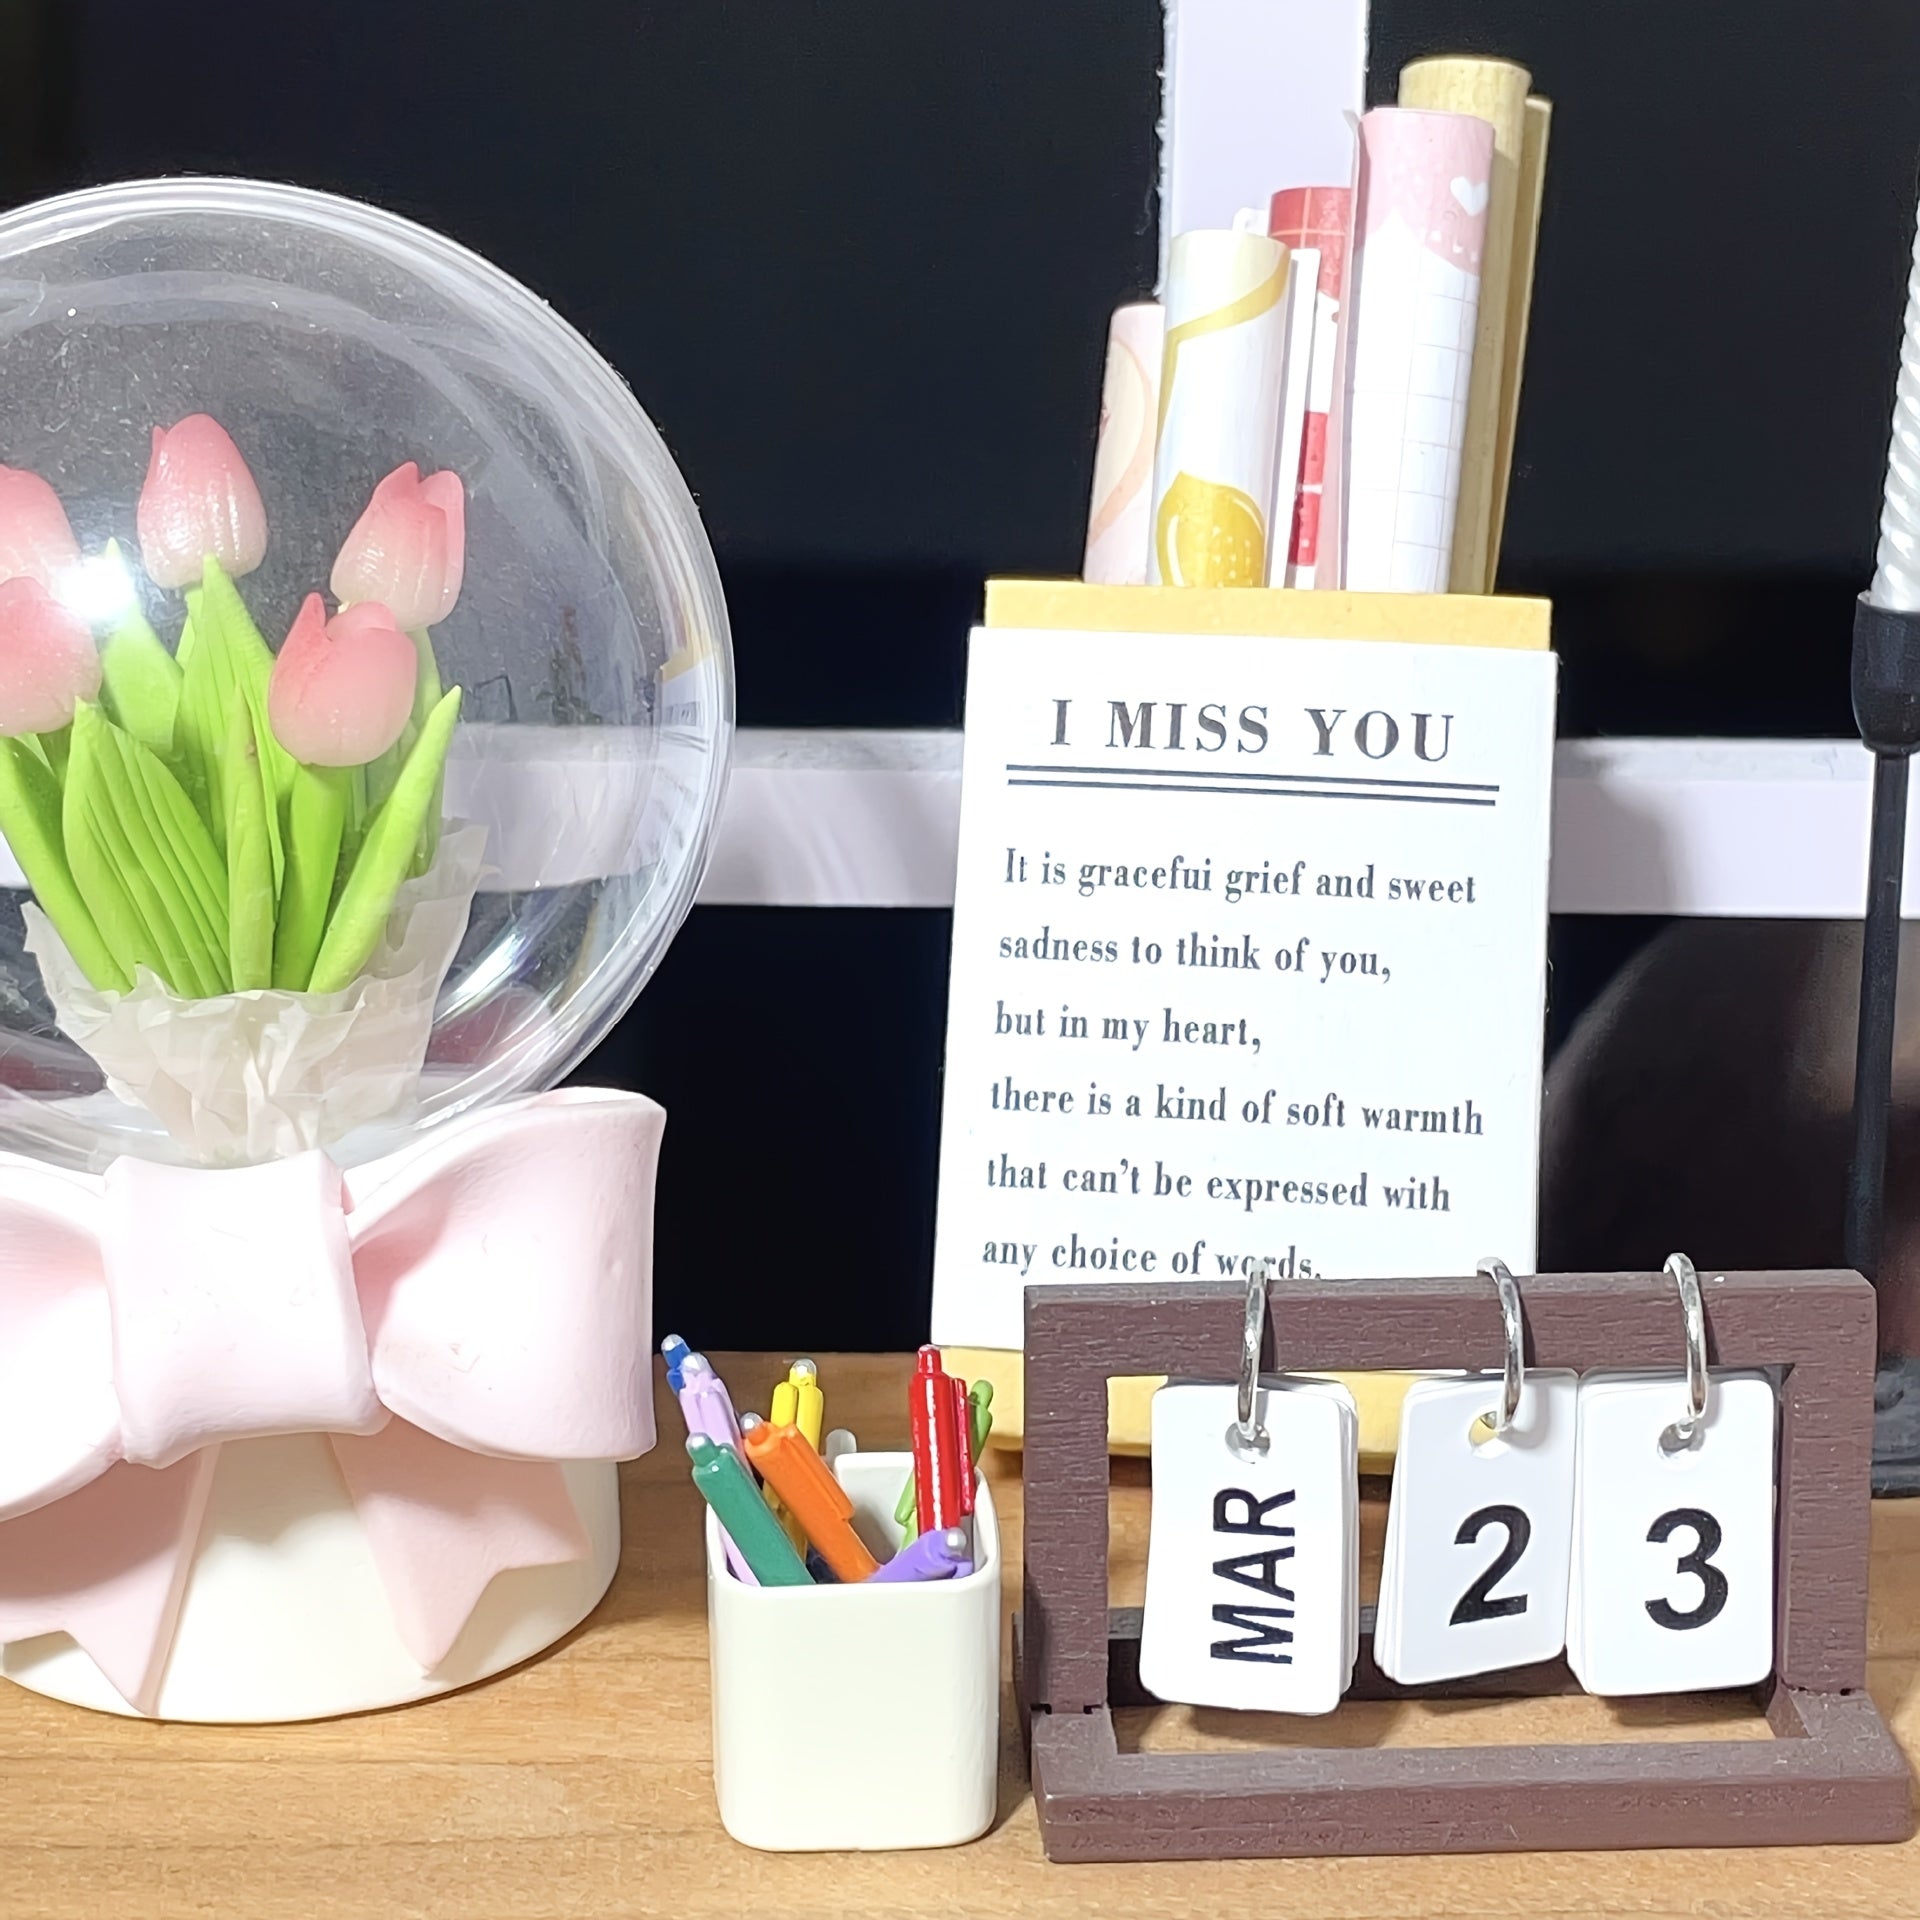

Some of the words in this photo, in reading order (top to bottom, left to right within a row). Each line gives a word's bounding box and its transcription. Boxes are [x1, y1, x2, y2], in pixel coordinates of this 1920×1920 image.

[1050, 699, 1072, 746] I
[1105, 700, 1268, 754] MISS
[1304, 708, 1454, 762] YOU
[1006, 848, 1027, 883] It
[1042, 851, 1066, 884] is
[1225, 860, 1306, 904] grief
[1316, 864, 1374, 899] and
[1388, 876, 1476, 903] sweet
[1000, 925, 1118, 962] sadness
[1132, 936, 1162, 964] to
[1178, 932, 1260, 970] think
[1275, 937, 1310, 972] of
[1320, 951, 1391, 984] you,
[995, 1000, 1045, 1036] but
[1059, 1005, 1088, 1038] in
[1102, 1018, 1150, 1051] my
[1163, 1007, 1261, 1053] heart,
[992, 1076, 1074, 1113] there
[1087, 1082, 1112, 1115] is
[1125, 1095, 1141, 1117] a
[1157, 1083, 1226, 1122] kind
[1242, 1089, 1277, 1124] of
[1287, 1092, 1345, 1128] soft
[1361, 1099, 1483, 1135] warmth
[988, 1153, 1047, 1189] that
[1063, 1158, 1139, 1194] can't
[1154, 1161, 1192, 1196] be
[1207, 1172, 1368, 1212] expressed
[1383, 1176, 1449, 1212] with
[982, 1242, 1035, 1276] any
[1051, 1233, 1157, 1272] choice
[1171, 1240, 1206, 1275] of
[1209, 1487, 1296, 1665] MAR
[1448, 1504, 1532, 1627] 2
[1644, 1507, 1729, 1631] 3
